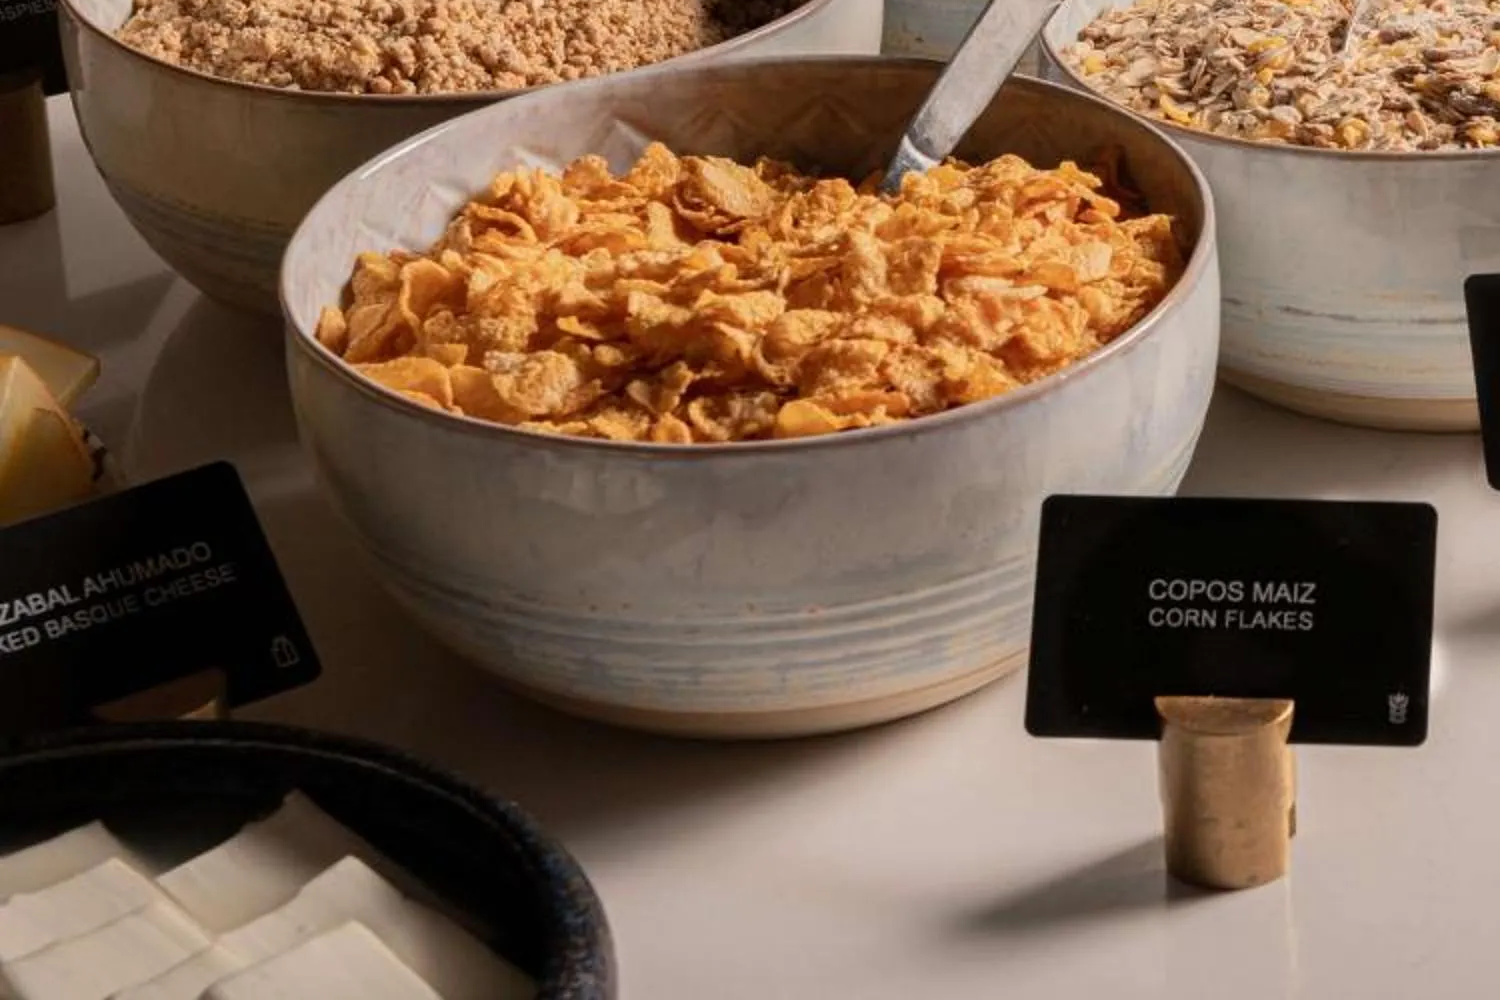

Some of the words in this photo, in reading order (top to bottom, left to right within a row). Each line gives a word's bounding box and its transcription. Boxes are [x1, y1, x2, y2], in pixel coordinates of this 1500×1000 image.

[83, 541, 213, 597] AHUMADO
[45, 593, 139, 639] BASQUE
[145, 562, 237, 606] CHEESE
[1149, 578, 1245, 602] COPOS
[1252, 581, 1317, 605] MAIZ
[1149, 607, 1217, 628] CORN
[1224, 609, 1314, 631] FLAKES
